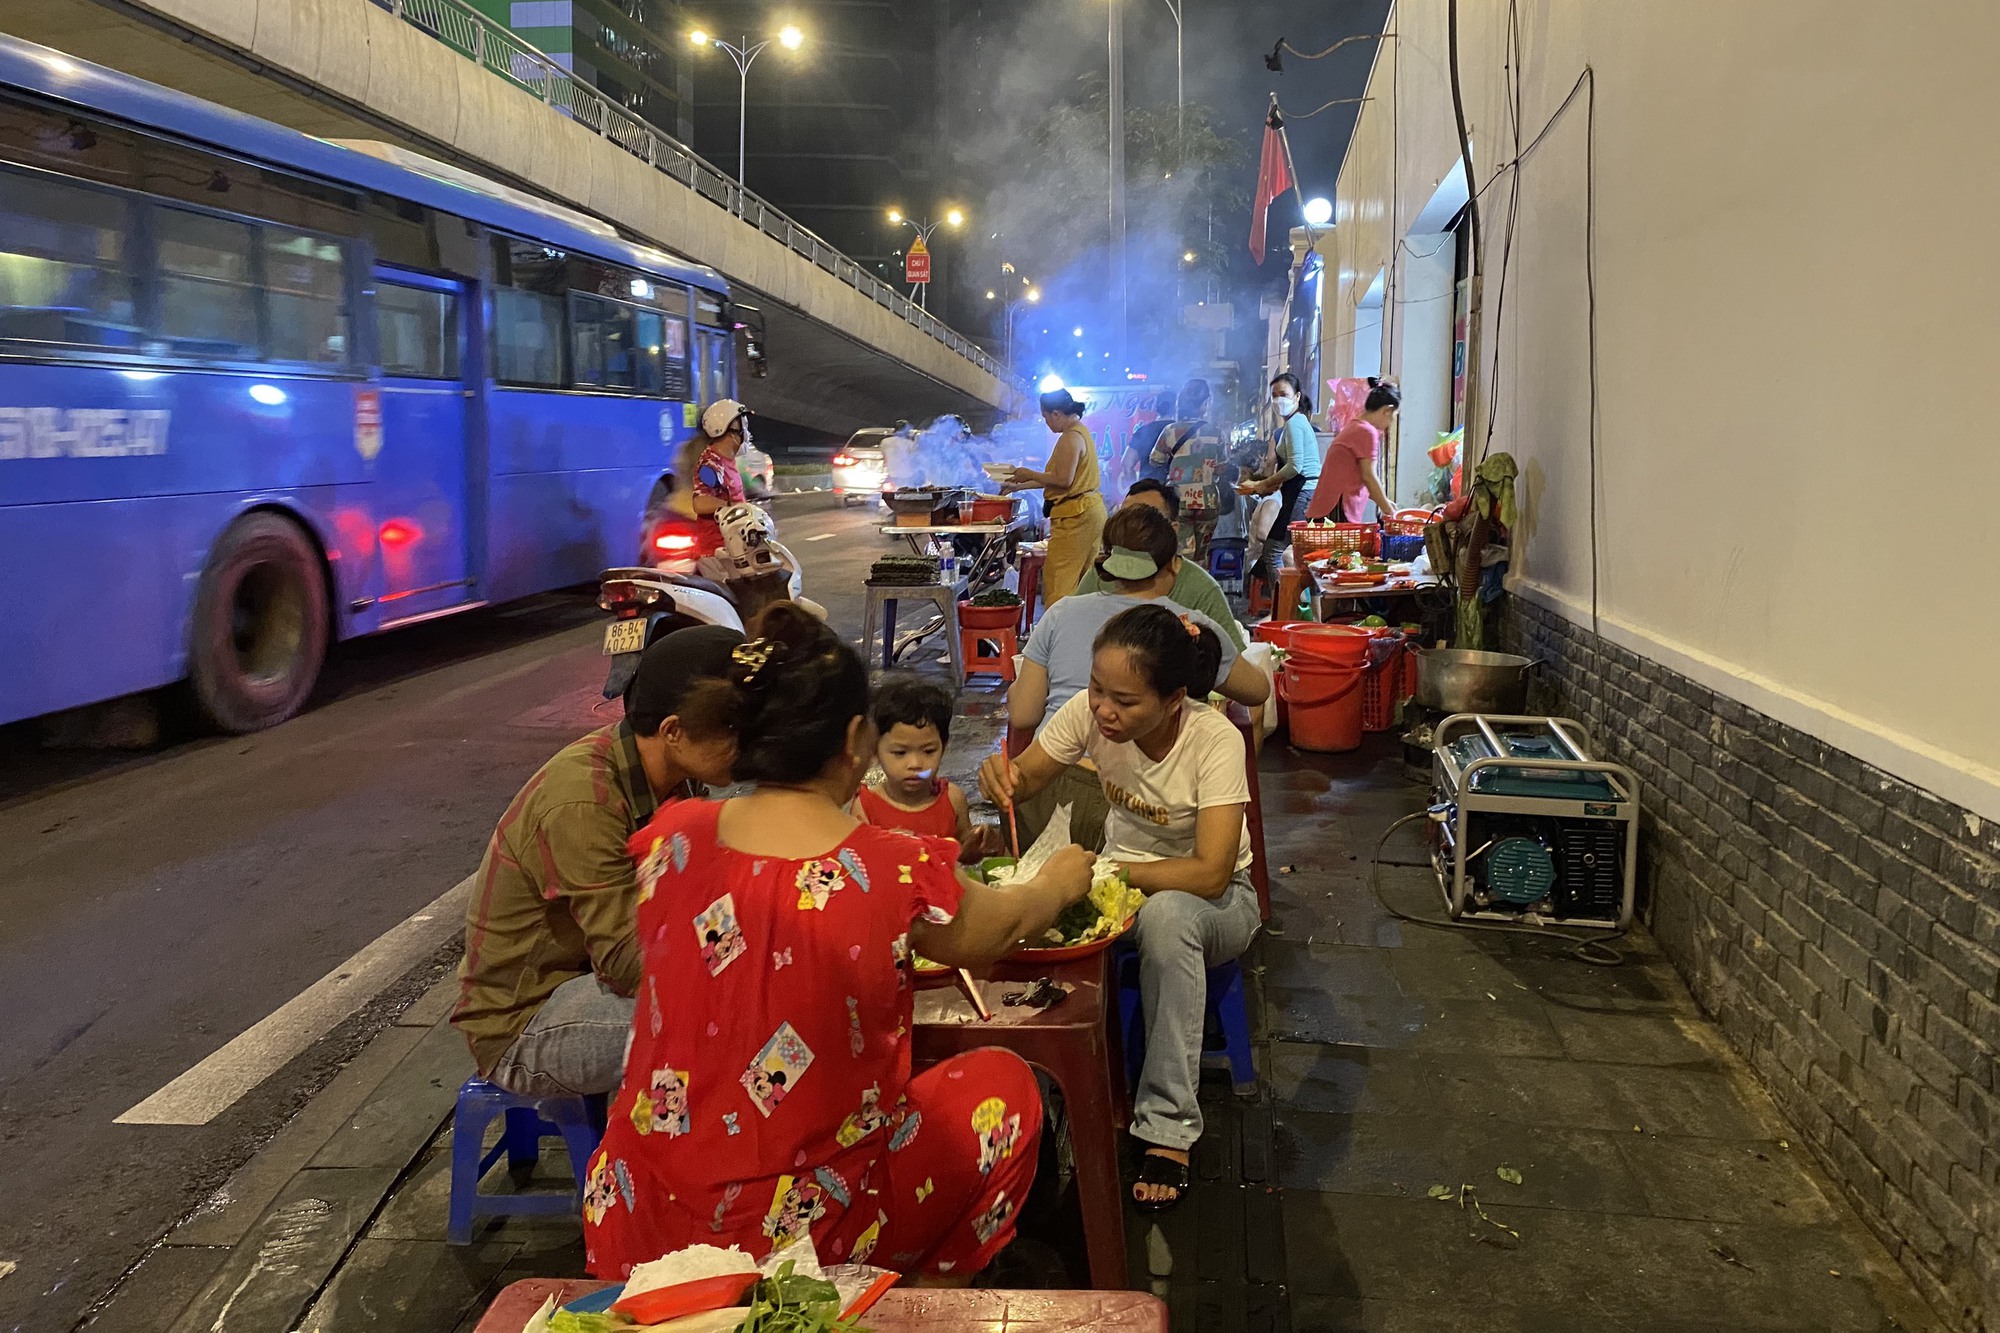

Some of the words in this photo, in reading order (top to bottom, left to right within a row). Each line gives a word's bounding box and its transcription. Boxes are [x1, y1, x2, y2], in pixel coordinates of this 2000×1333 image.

[1184, 487, 1204, 500] nice
[612, 621, 639, 637] 86-B4
[606, 634, 641, 653] 402.71
